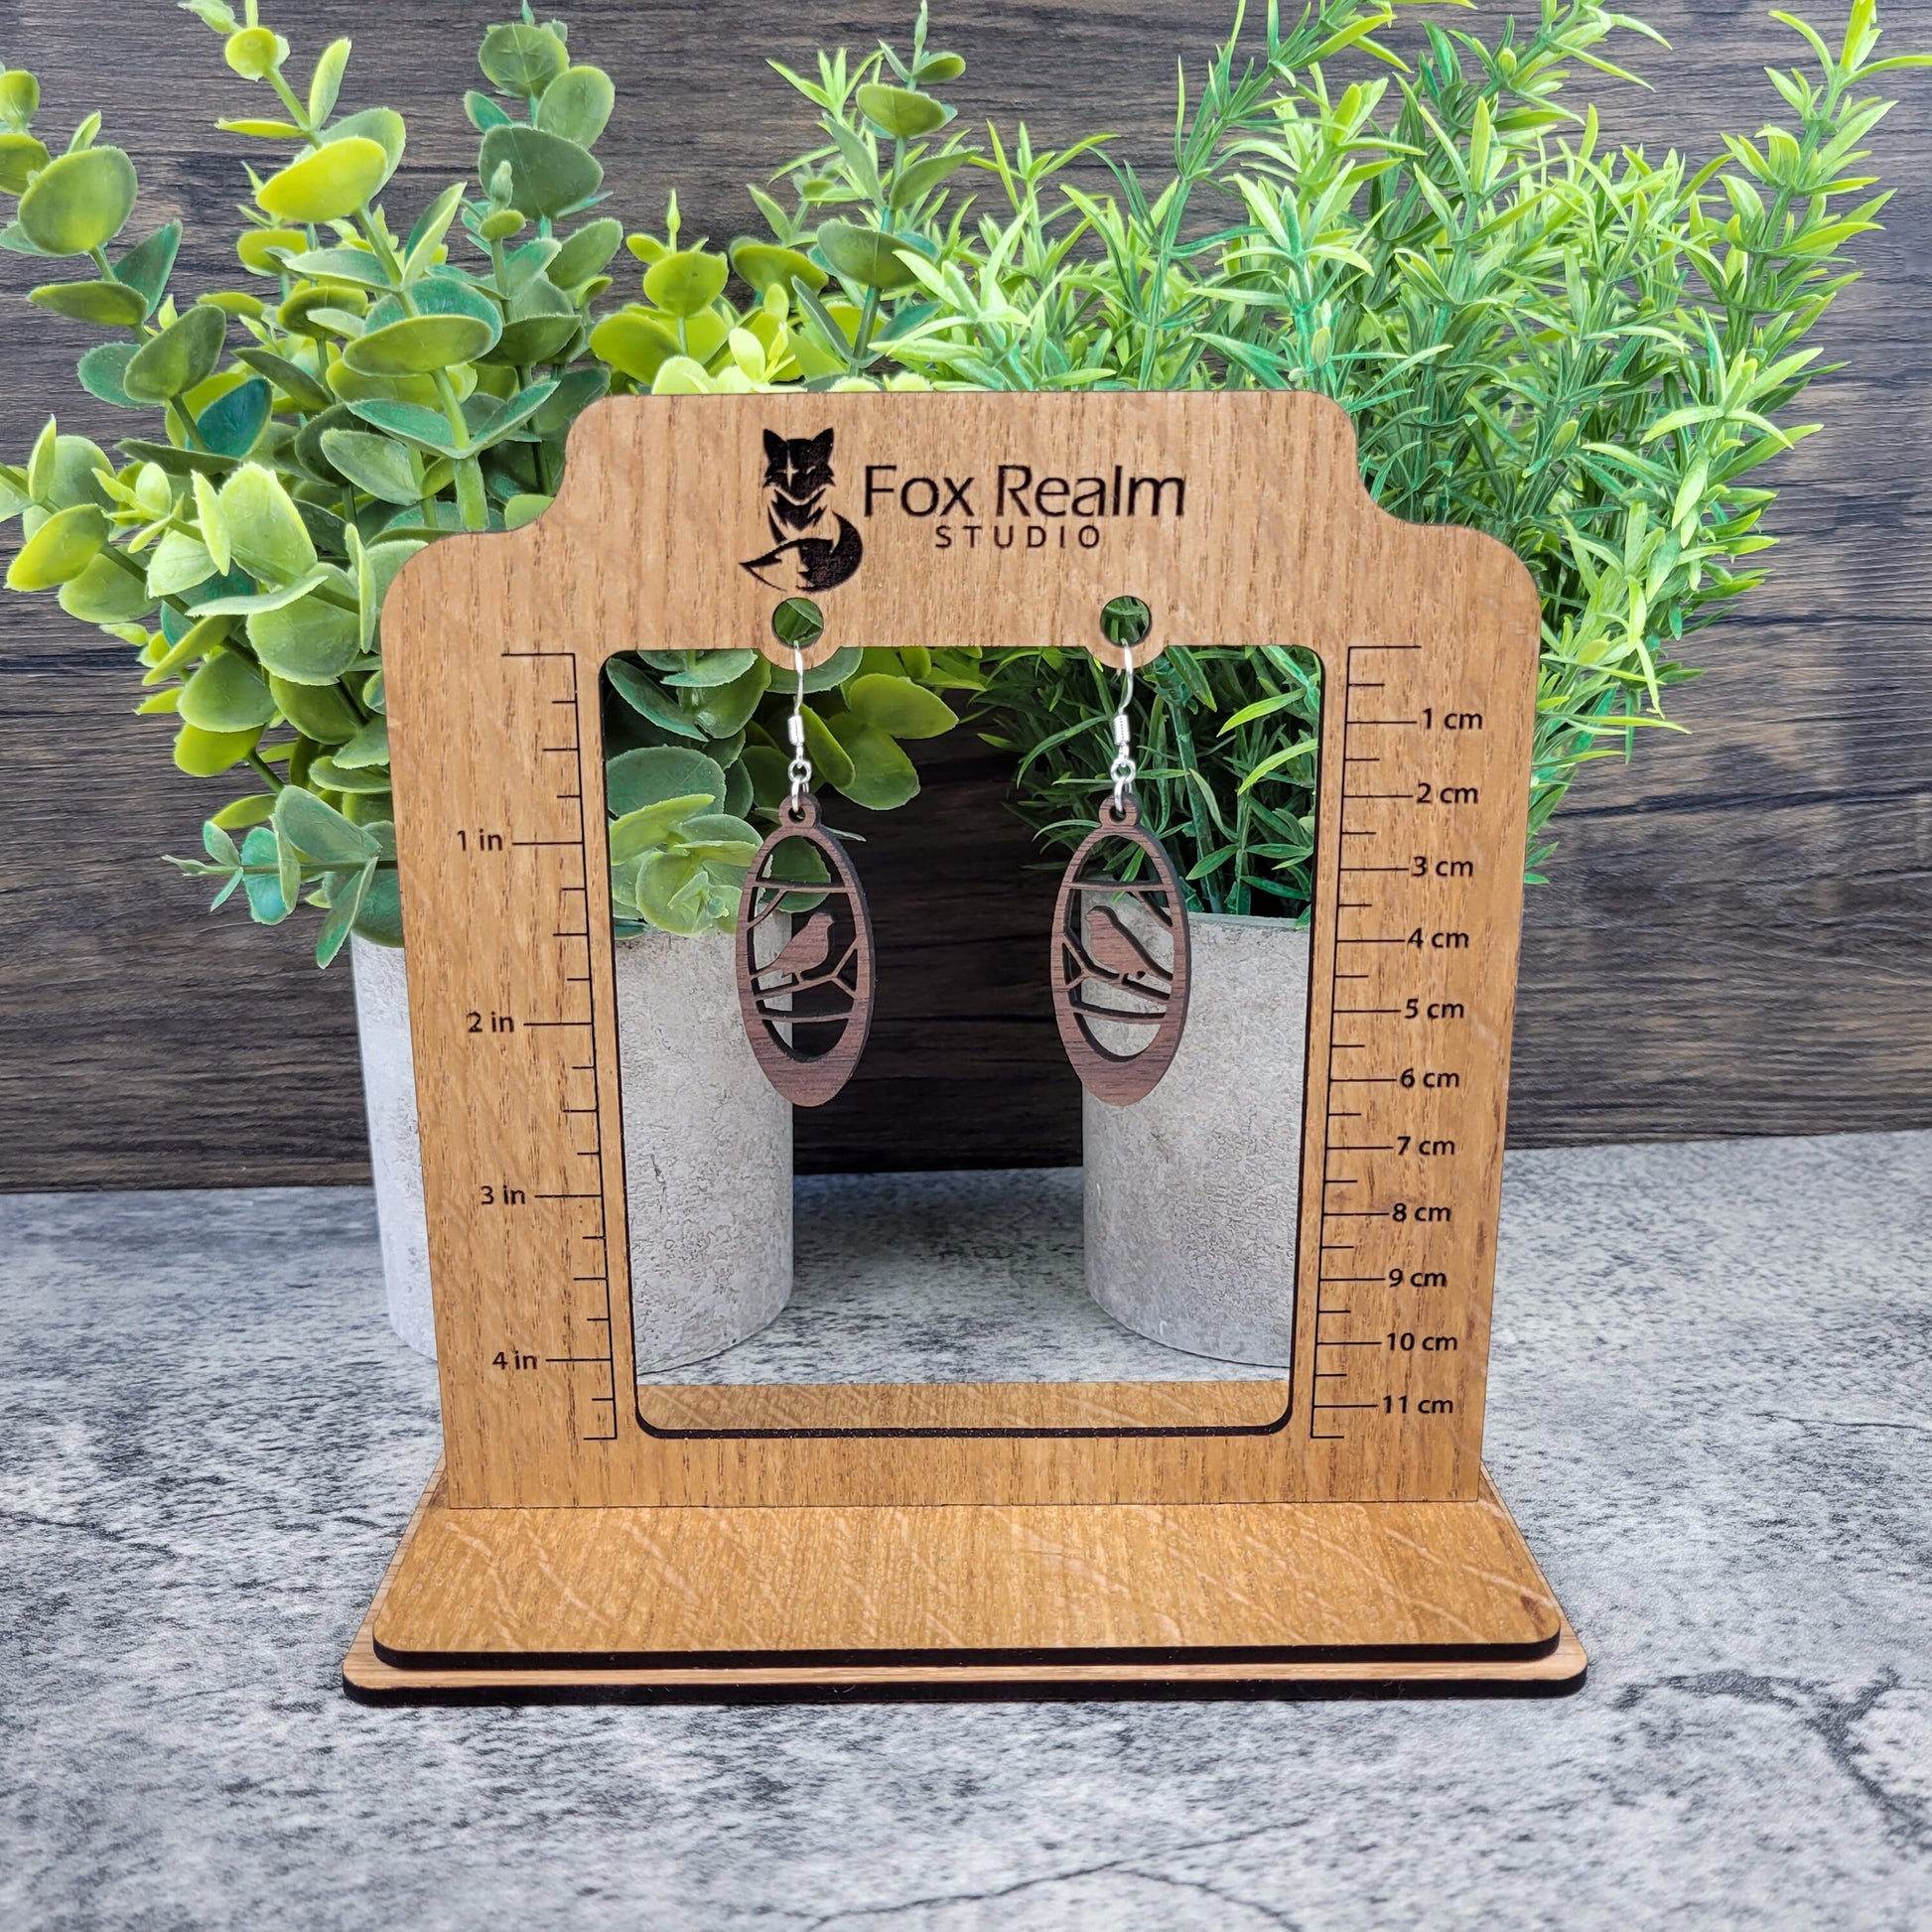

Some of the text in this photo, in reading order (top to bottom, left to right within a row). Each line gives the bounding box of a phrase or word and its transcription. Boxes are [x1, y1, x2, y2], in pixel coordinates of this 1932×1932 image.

[864, 466, 1185, 516] Fox Realm
[935, 525, 1100, 548] STUDIO
[1423, 709, 1483, 730] 1 cm
[1417, 782, 1478, 804] 2 cm
[457, 829, 502, 851] 1 in
[1411, 857, 1473, 877] 3 cm
[1408, 928, 1468, 948] 4 cm
[1404, 999, 1464, 1019] 5 cm
[467, 1011, 514, 1033] 2 in
[1400, 1068, 1459, 1088] 6 cm
[1397, 1136, 1454, 1156] 7 cm
[481, 1184, 525, 1205] 3 in
[1392, 1203, 1450, 1222] 8 cm
[1388, 1268, 1447, 1287] 9 cm
[1387, 1332, 1457, 1350] 10 cm
[492, 1350, 537, 1370] 4 in
[1383, 1396, 1453, 1414] 11 cm
